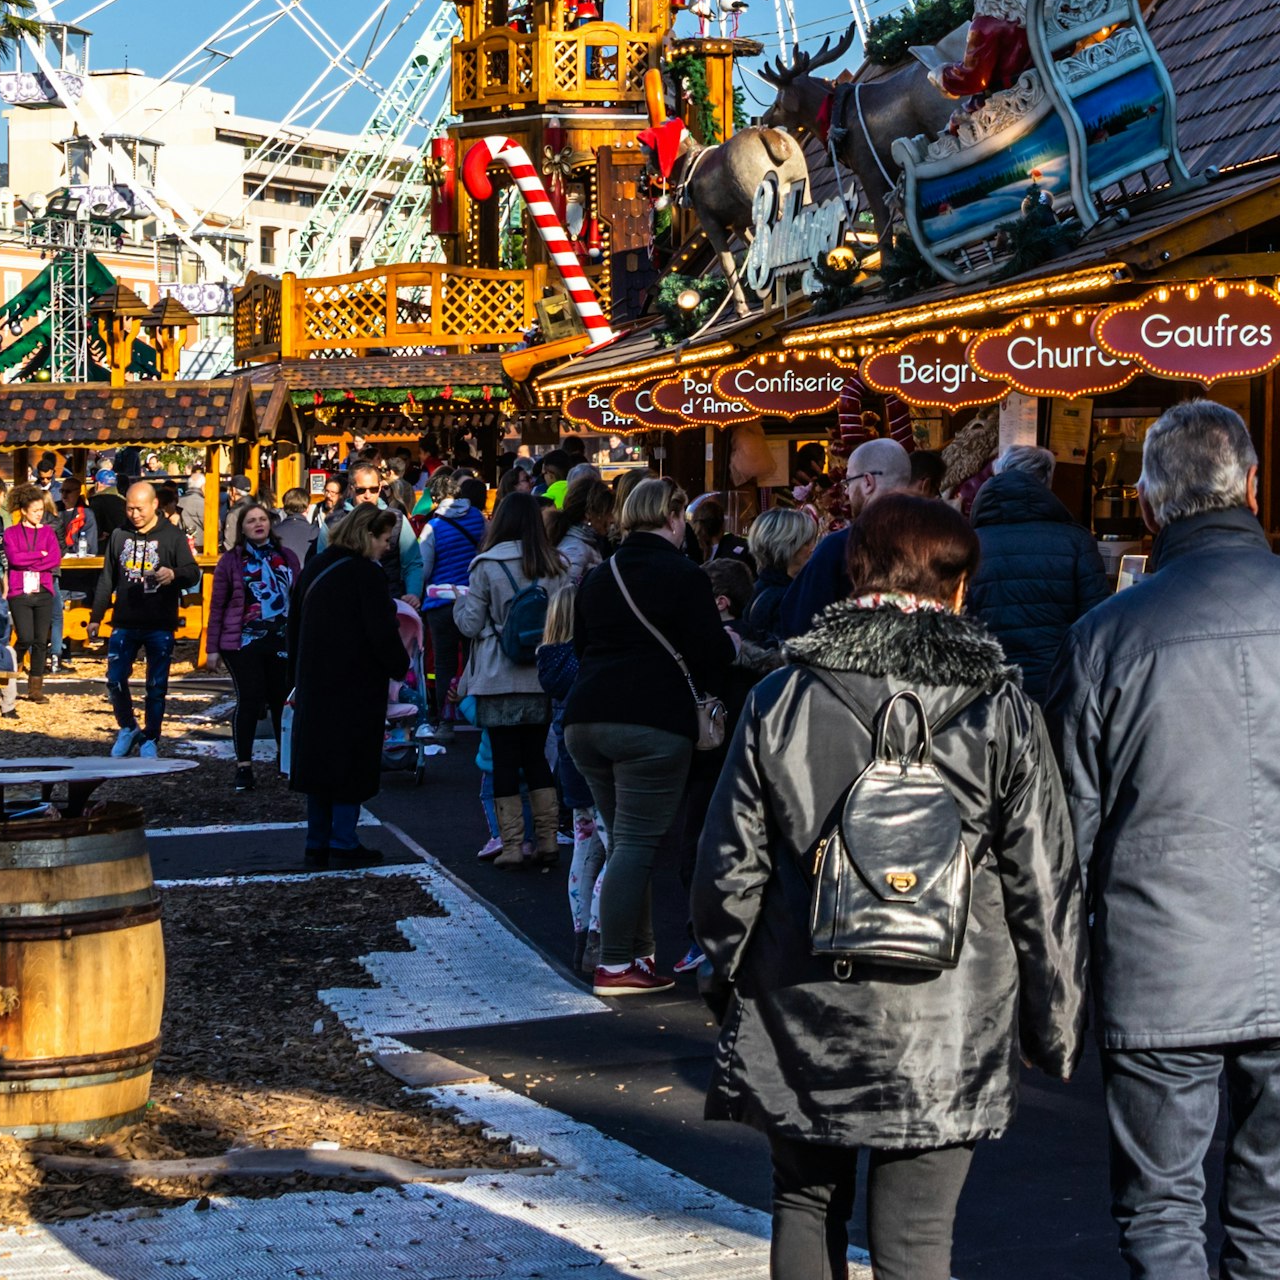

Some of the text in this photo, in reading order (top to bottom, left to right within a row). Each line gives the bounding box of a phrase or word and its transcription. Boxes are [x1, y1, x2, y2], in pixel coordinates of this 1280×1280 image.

[1140, 313, 1273, 348] Gaufres
[1007, 336, 1131, 370] Churro
[734, 369, 845, 394] Confiserie
[897, 355, 989, 394] Beign
[680, 397, 750, 415] d'Amo
